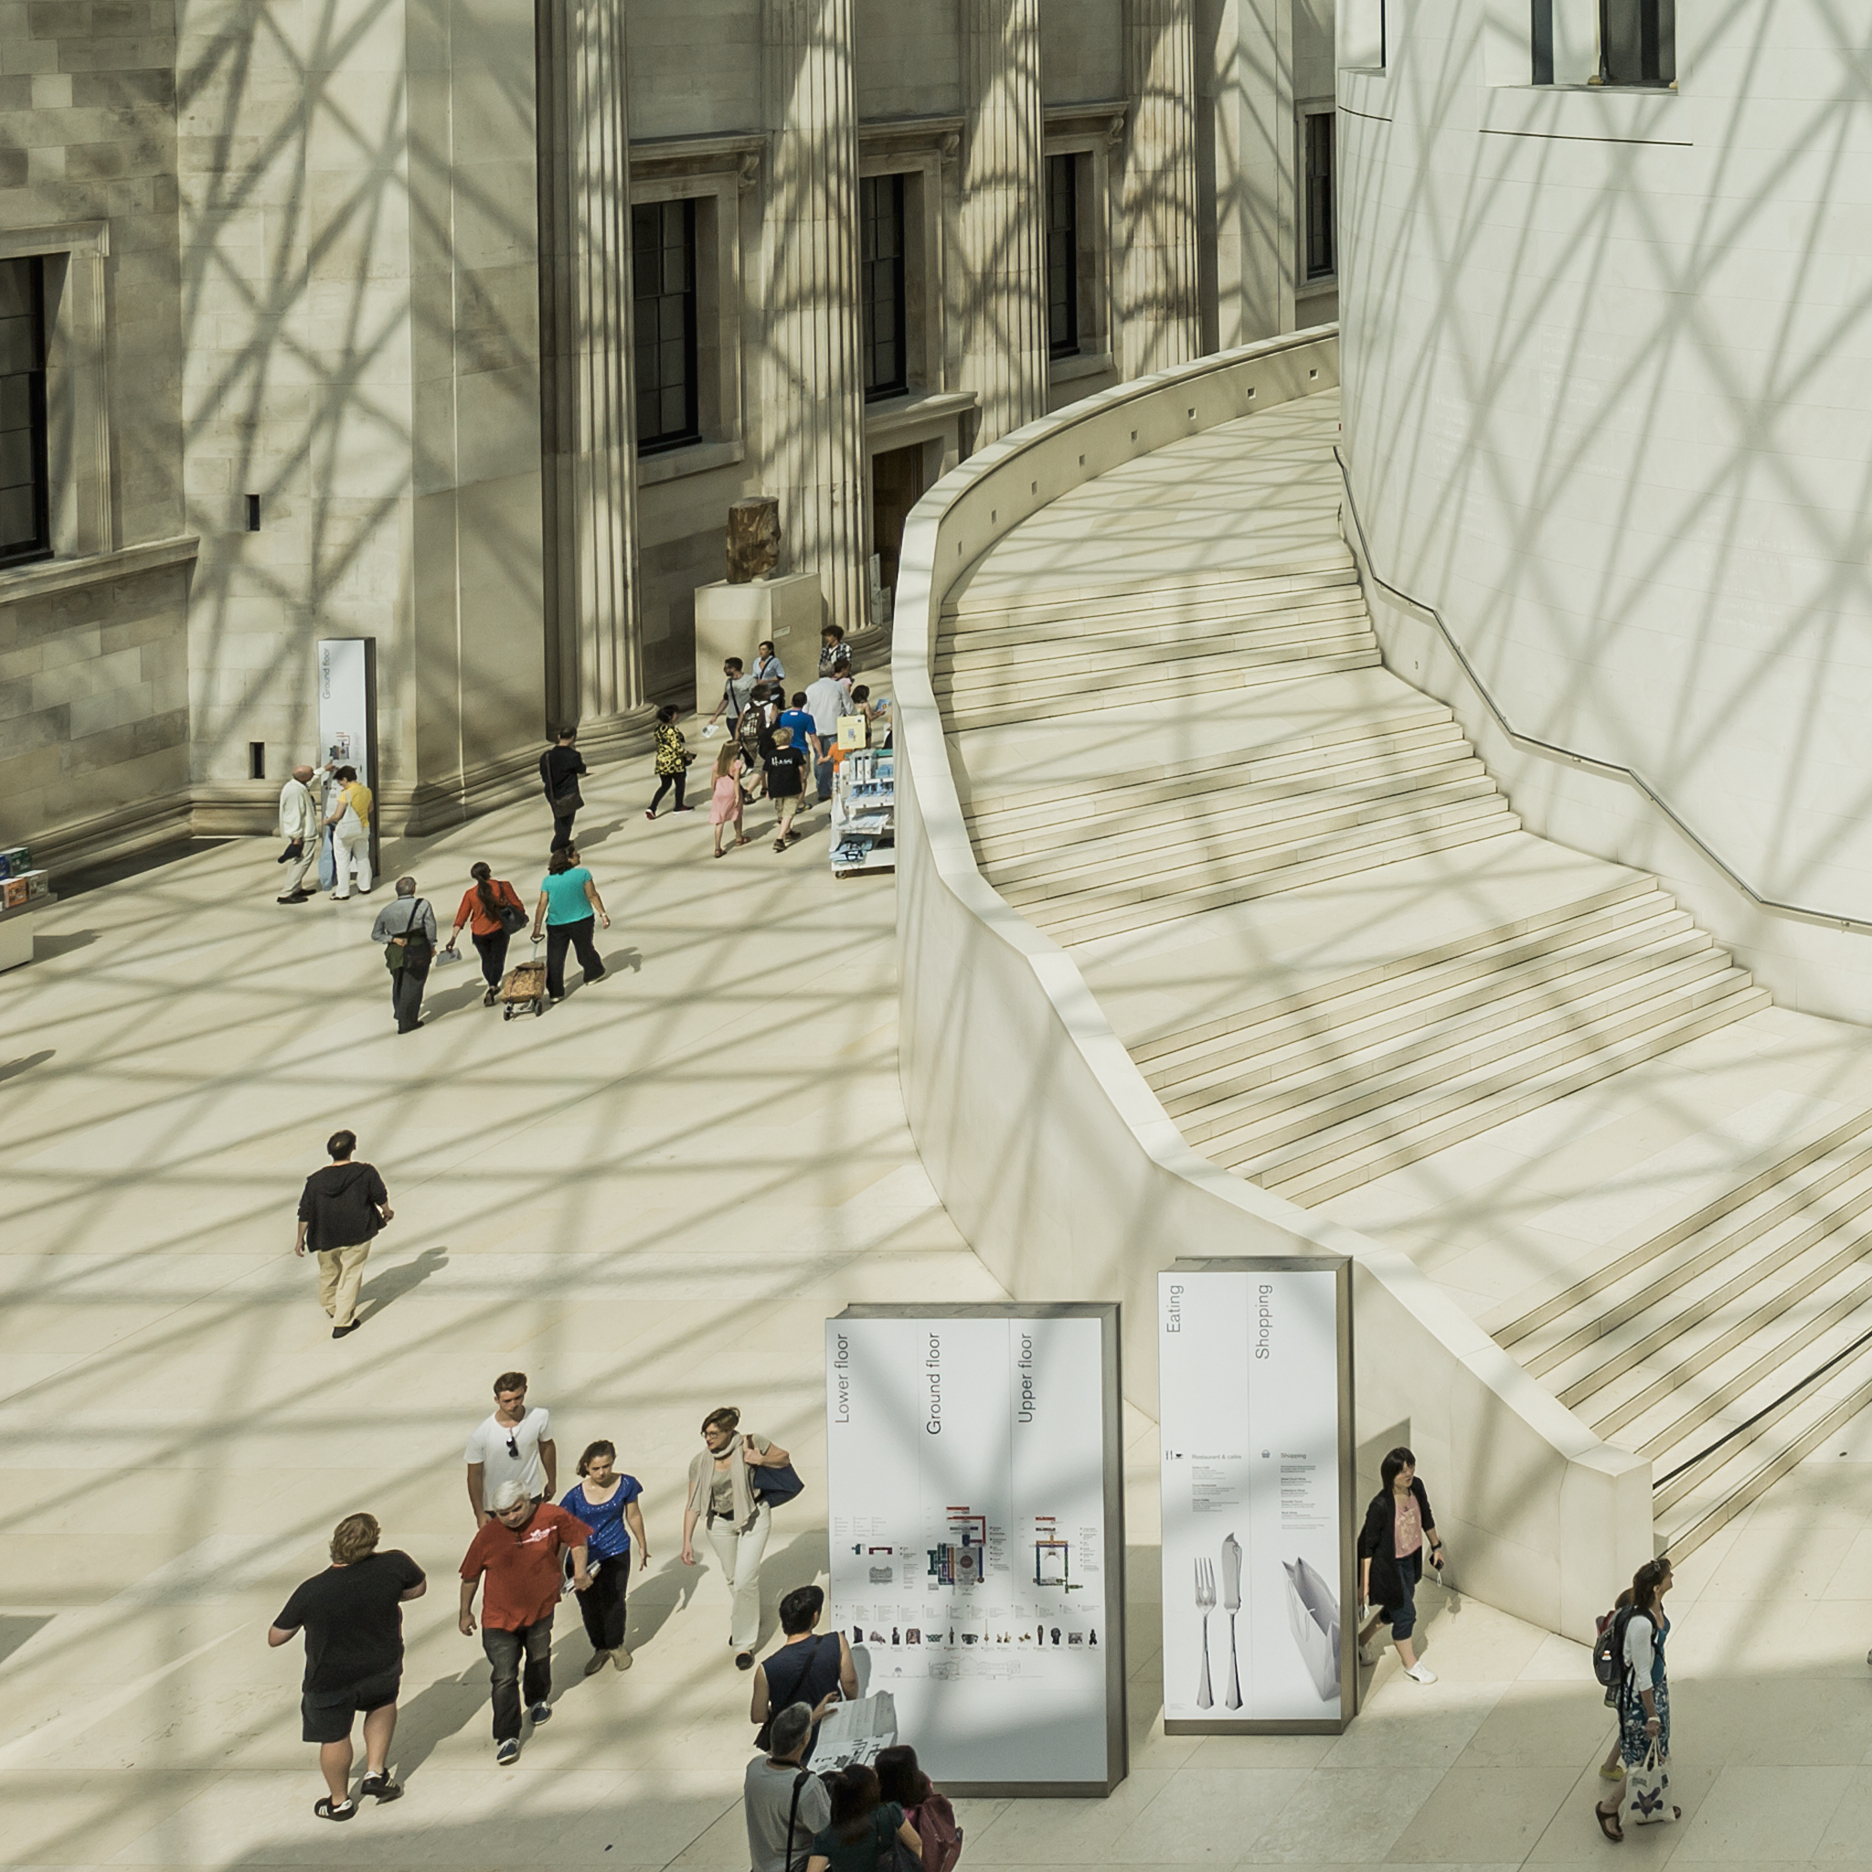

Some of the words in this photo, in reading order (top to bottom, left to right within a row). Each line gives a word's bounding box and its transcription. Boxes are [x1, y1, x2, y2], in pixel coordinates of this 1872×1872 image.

[1166, 1284, 1184, 1333] Eating
[1255, 1284, 1273, 1360] Shopping
[834, 1333, 848, 1369] floor
[925, 1332, 940, 1368] floor
[1018, 1333, 1032, 1369] floor
[835, 1374, 849, 1423] Lower
[926, 1374, 942, 1435] Ground
[1018, 1374, 1036, 1423] Upper
